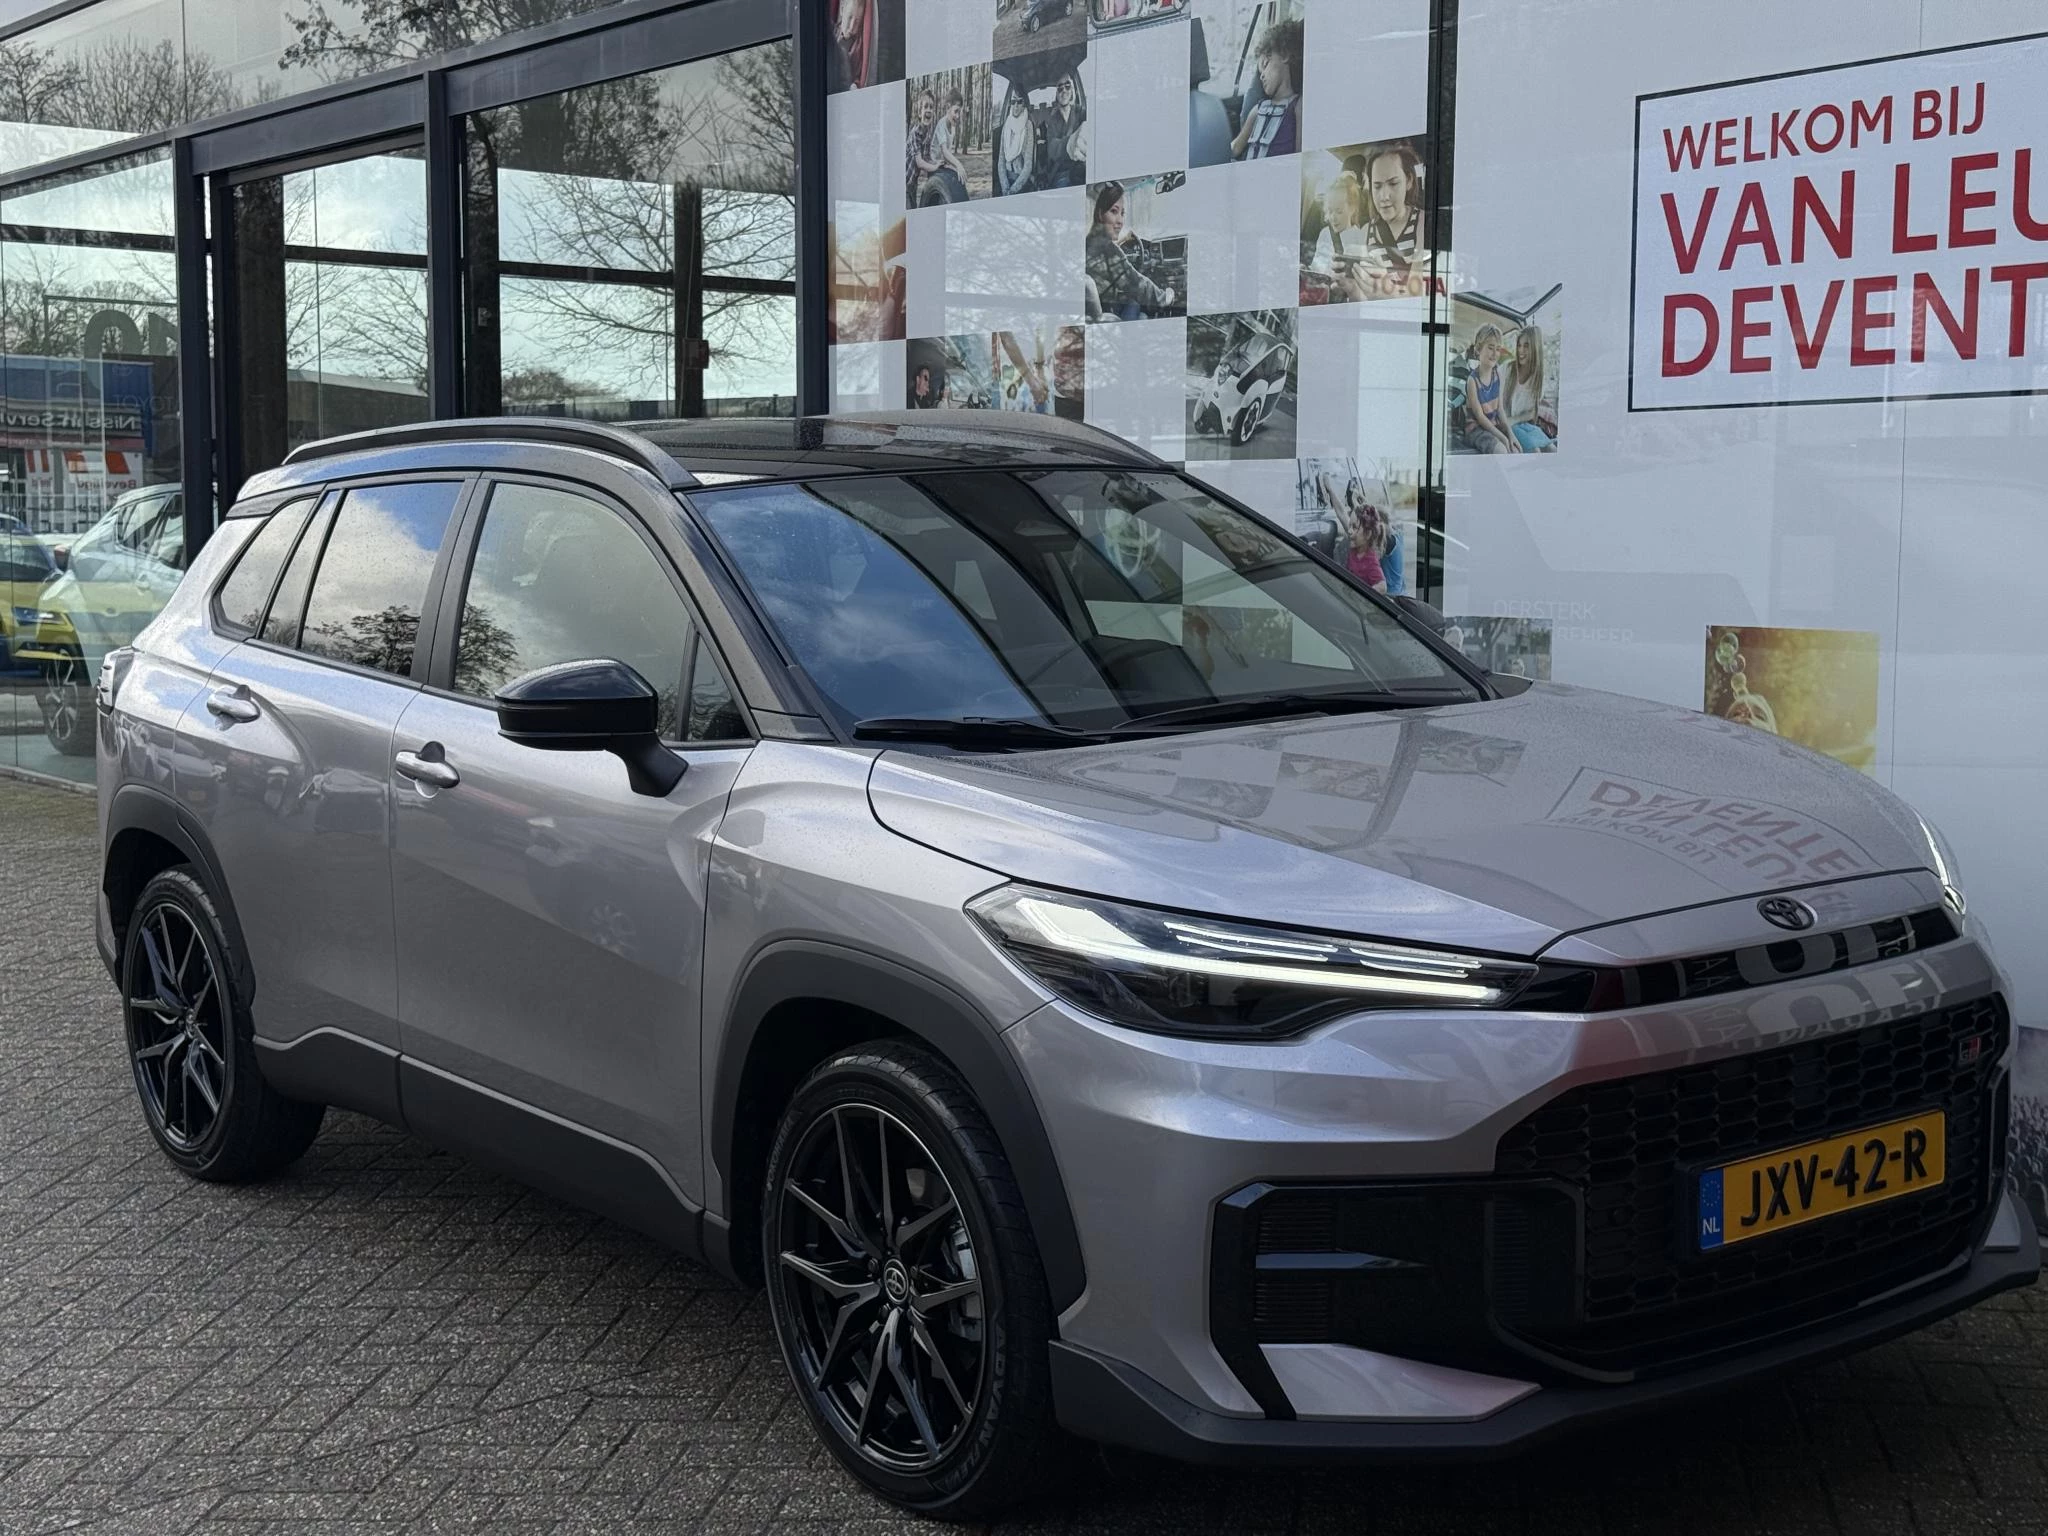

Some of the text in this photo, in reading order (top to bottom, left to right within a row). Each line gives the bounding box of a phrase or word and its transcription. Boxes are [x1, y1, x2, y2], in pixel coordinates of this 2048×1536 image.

[1662, 81, 1986, 173] WELKOM BIJ
[1660, 169, 1856, 275] VAN
[1661, 261, 2048, 378] DEVENT
[1702, 1215, 1721, 1236] NL
[1739, 1126, 1929, 1228] JXV-42-R
